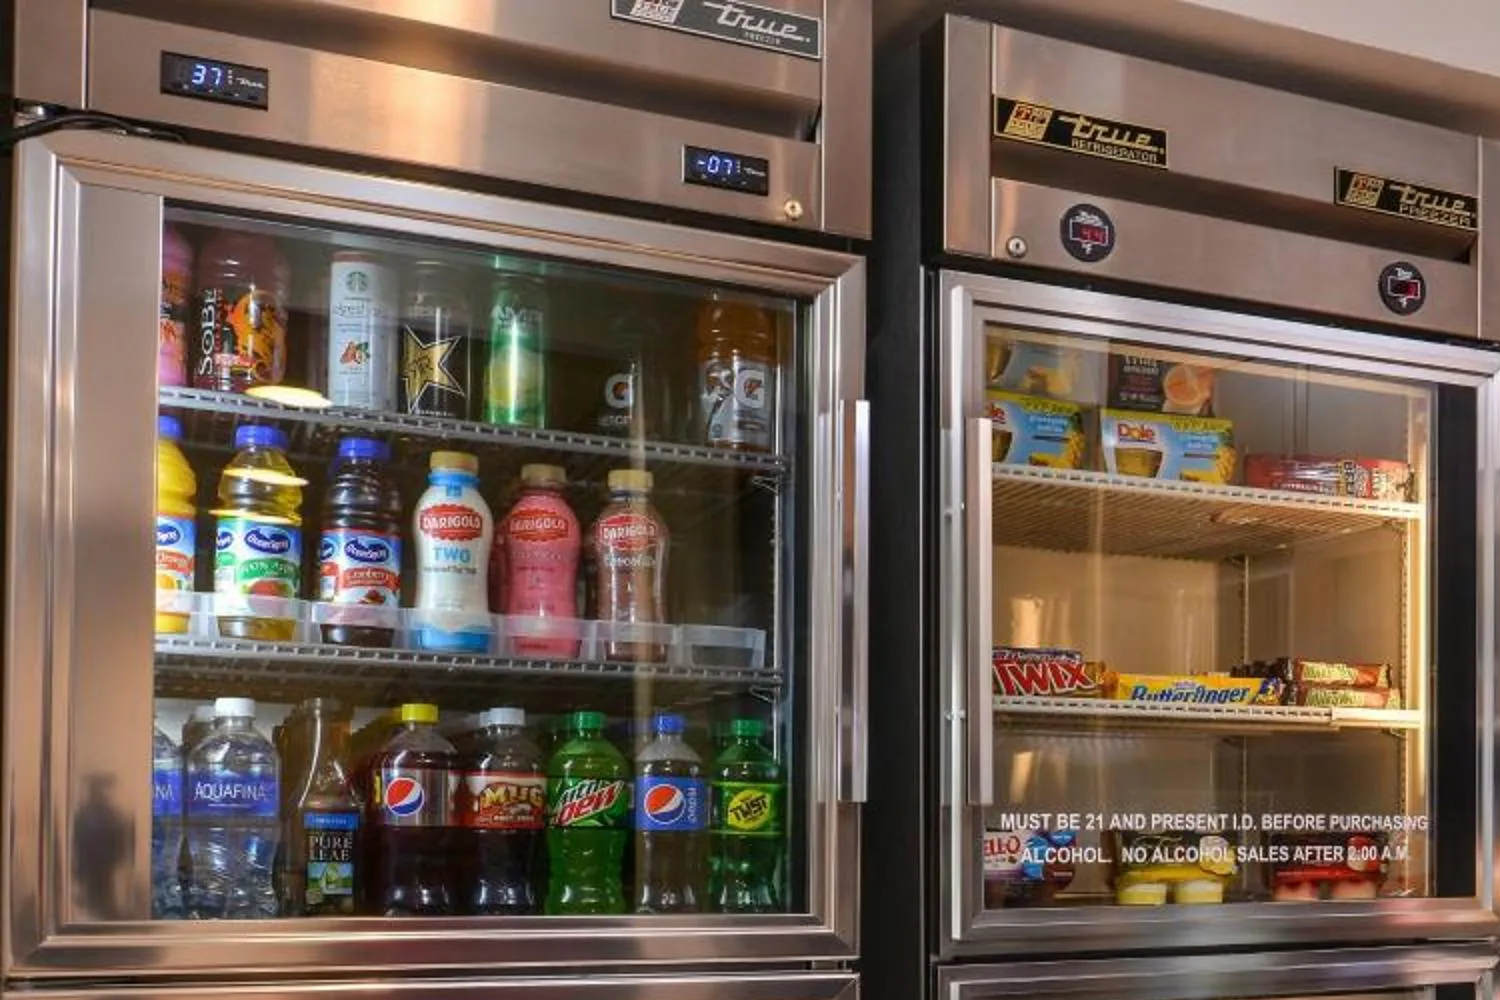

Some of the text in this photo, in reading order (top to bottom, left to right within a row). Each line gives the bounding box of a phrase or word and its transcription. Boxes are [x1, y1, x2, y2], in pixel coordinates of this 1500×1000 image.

[191, 63, 221, 85] 37
[1058, 115, 1165, 155] true
[1071, 139, 1158, 164] REFRIGERATOR
[1389, 184, 1477, 217] true
[1399, 204, 1471, 226] FREEZER
[422, 514, 481, 530] DARIGOLD
[434, 547, 471, 563] TWO
[993, 660, 1095, 696] TWIX
[1131, 682, 1250, 704] Butterfinger
[194, 782, 266, 800] AQUAFINA
[1001, 813, 1429, 831] MUST BE 21 AND PRESENT I.D. BEFORE PURCHASING
[308, 835, 353, 849] PURE
[1020, 846, 1112, 864] ALCOHOL.
[1122, 846, 1148, 864] NO
[1152, 846, 1230, 863] ALCOHOL
[1237, 845, 1289, 862] SALES
[1293, 845, 1344, 862] AFTER
